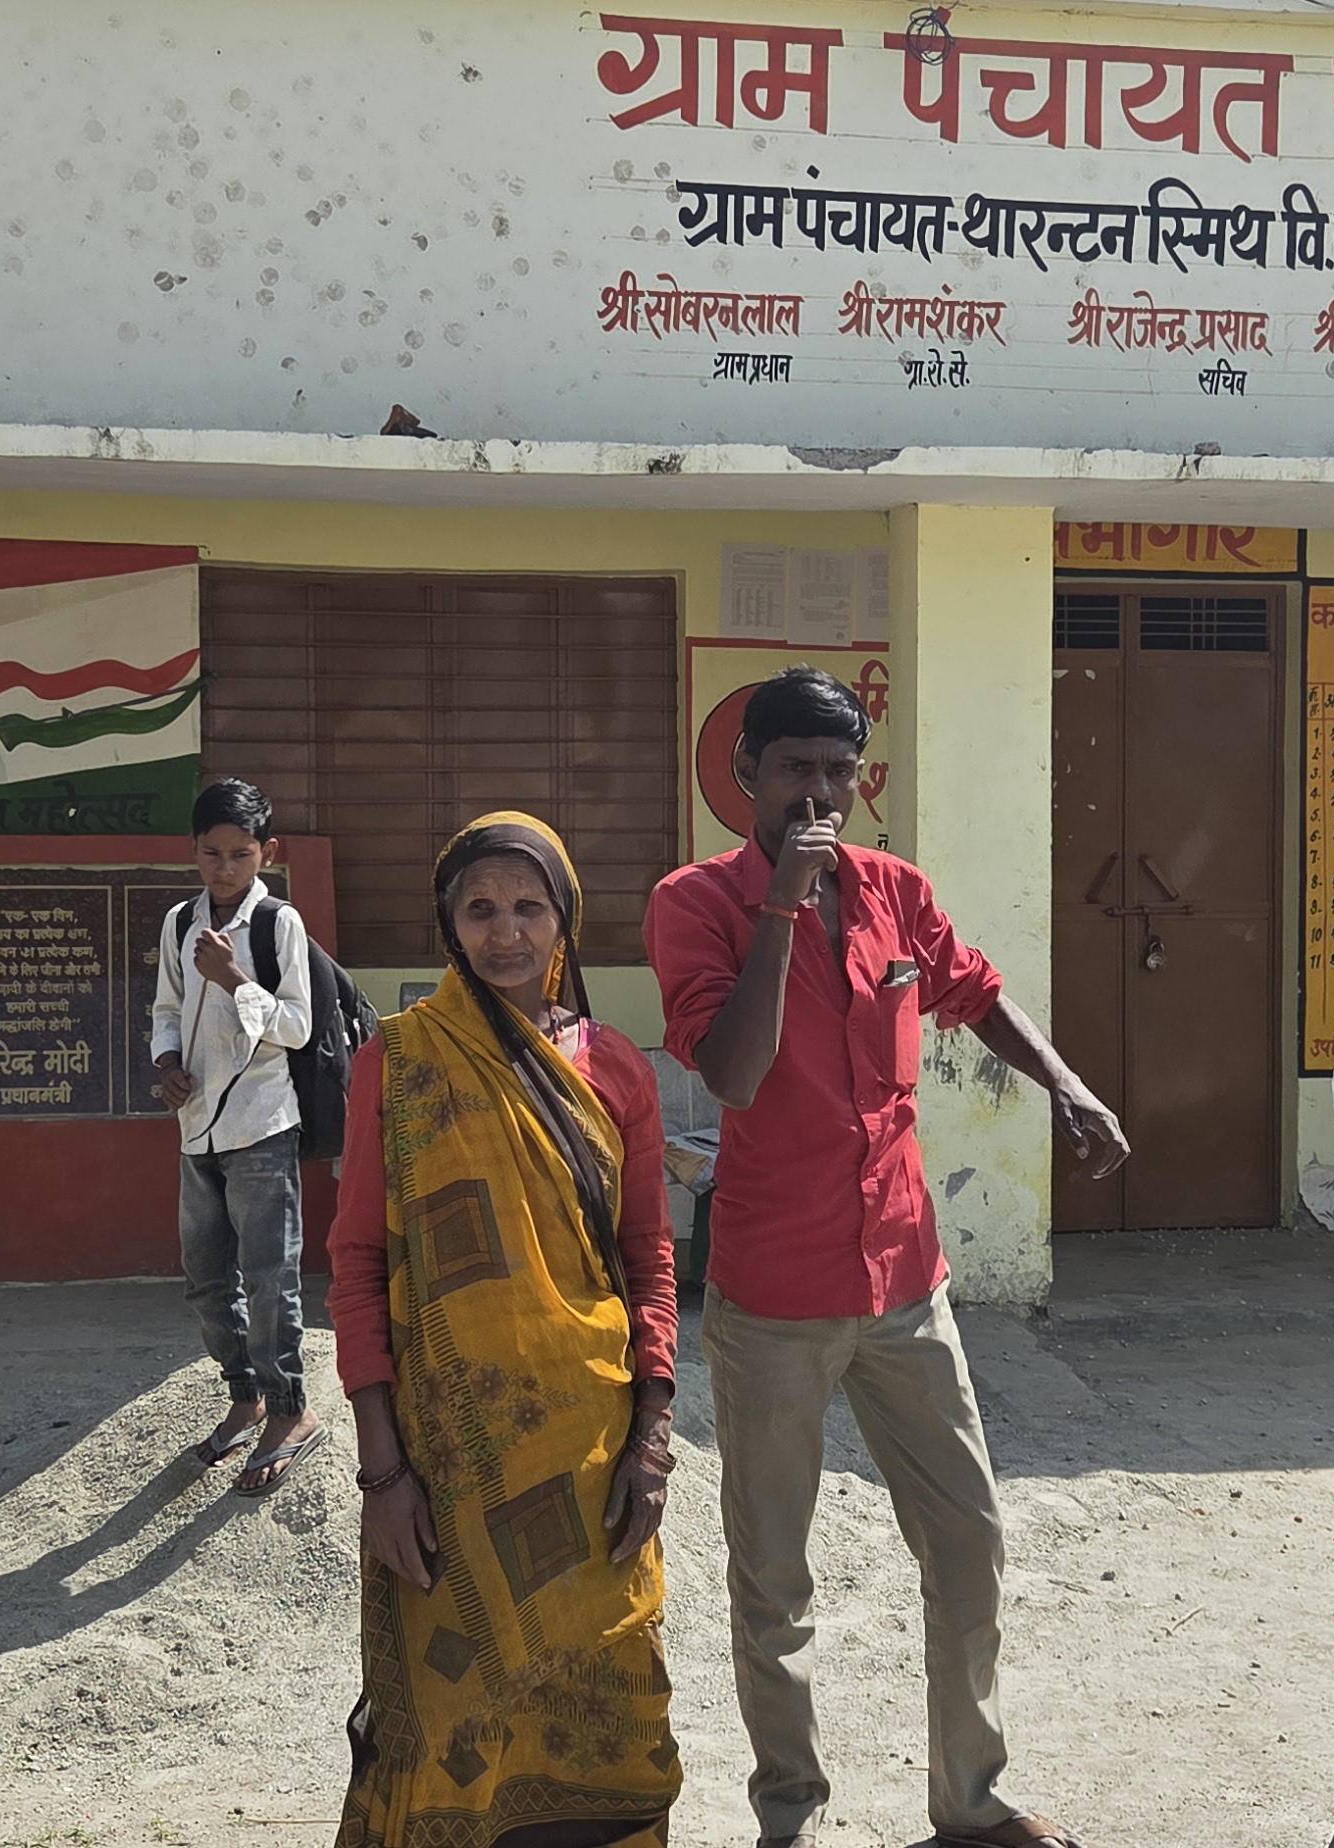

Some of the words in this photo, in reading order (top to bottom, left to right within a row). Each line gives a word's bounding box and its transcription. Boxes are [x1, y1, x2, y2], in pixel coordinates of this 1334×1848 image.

[597, 14, 844, 134] ग्राम
[883, 6, 1294, 163] पंचायत
[675, 179, 790, 248] ग्राम
[1141, 177, 1275, 273] स्मिथ
[597, 270, 645, 334] श्री
[838, 280, 876, 339] श्री
[876, 283, 1008, 347] रामशंकर
[1067, 287, 1107, 348] श्री
[1106, 290, 1195, 356] राजेन्द्र
[1191, 309, 1274, 357] प्रसाद
[713, 352, 750, 381] ग्राम
[749, 354, 793, 385] प्रधान
[1198, 358, 1247, 396] सचिव
[1311, 927, 1322, 943] 10
[1310, 954, 1322, 969] 11
[42, 1038, 92, 1075] मोदी
